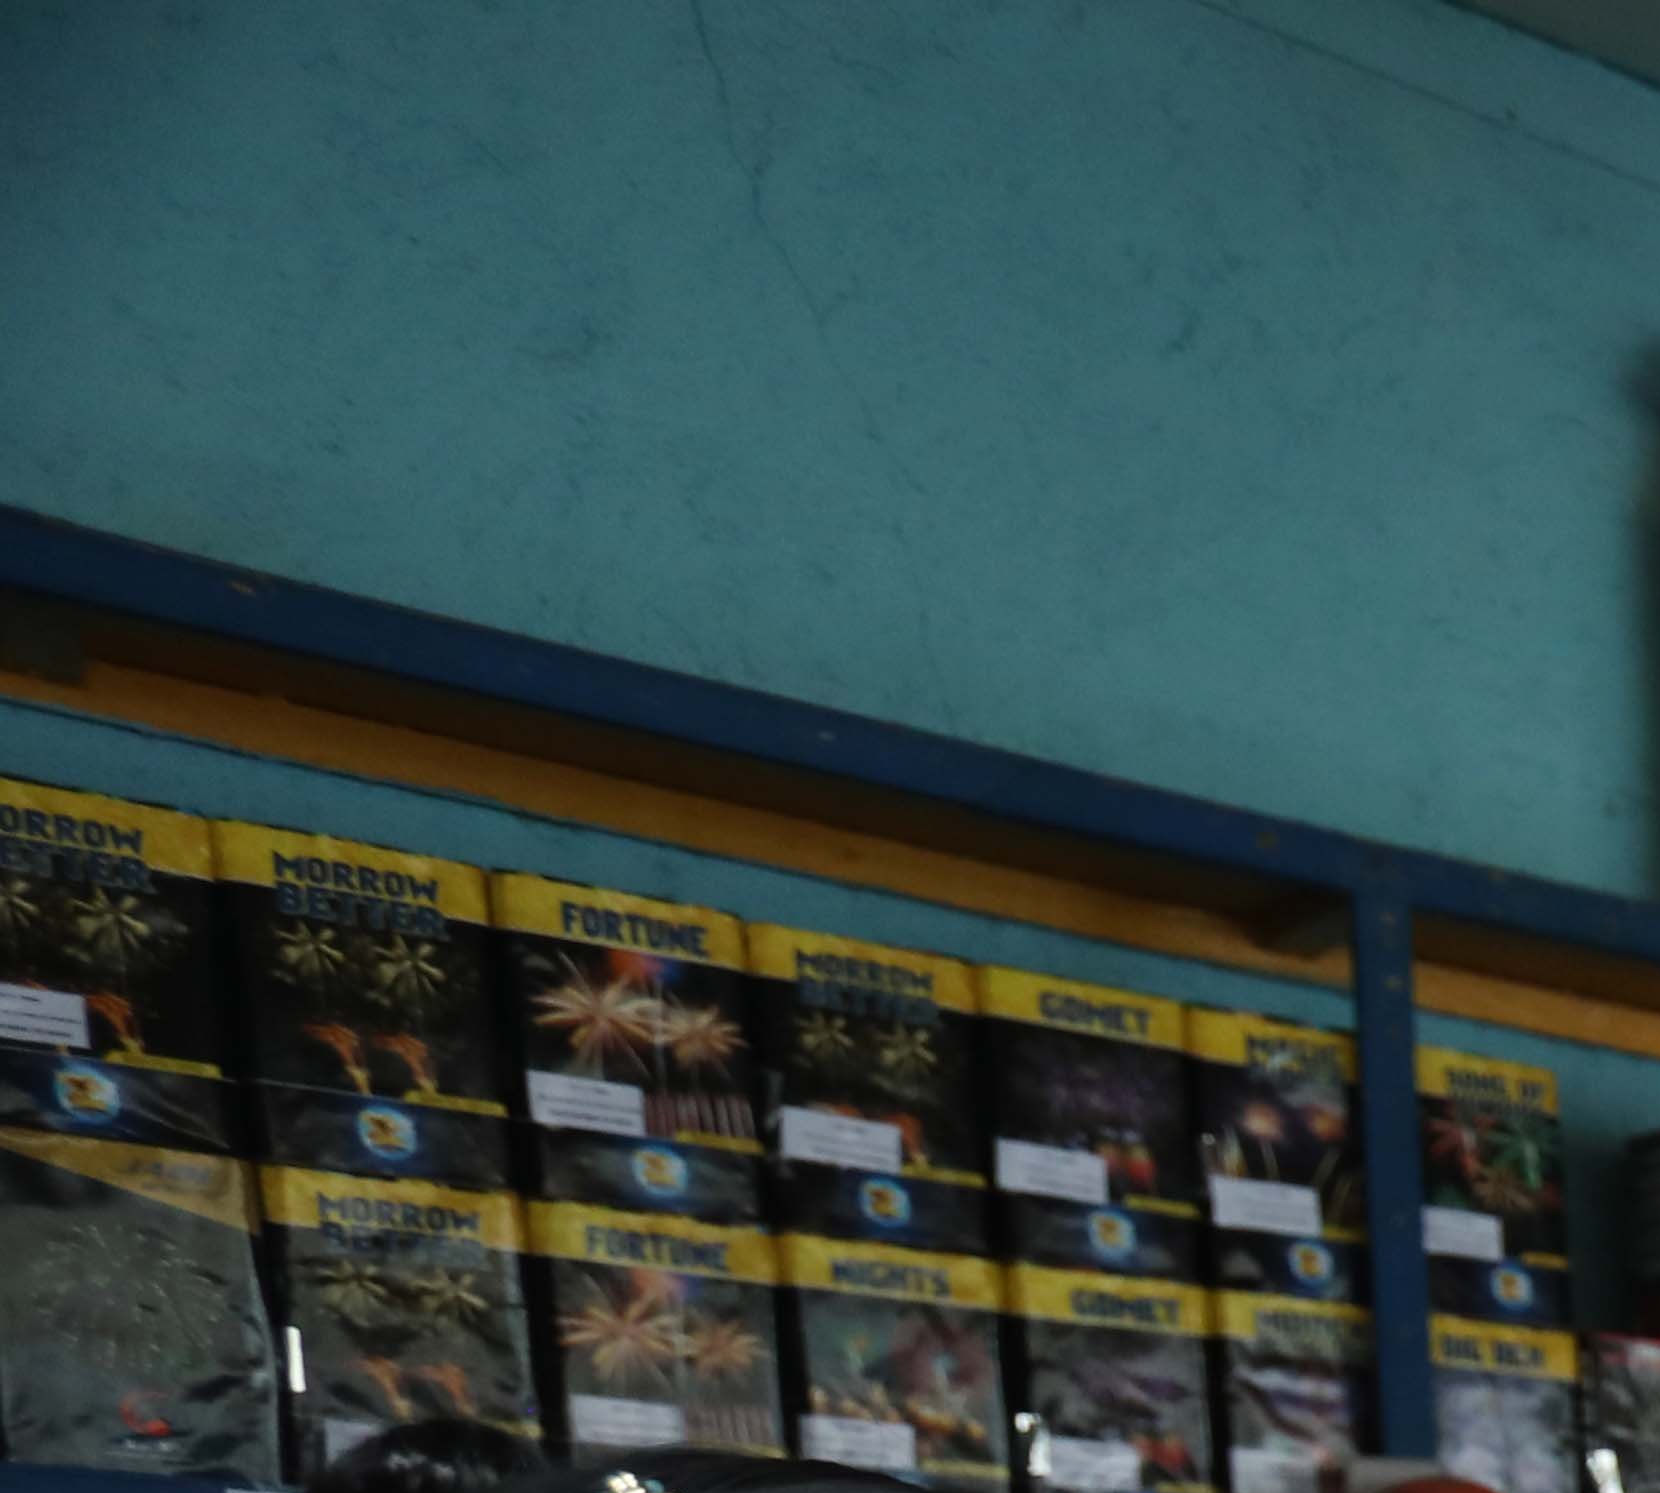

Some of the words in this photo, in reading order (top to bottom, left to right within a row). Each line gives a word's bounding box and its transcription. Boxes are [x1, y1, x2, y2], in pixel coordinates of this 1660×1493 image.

[272, 850, 439, 903] MORROW
[276, 883, 451, 941] BETTER
[560, 900, 710, 957] FORTUNE
